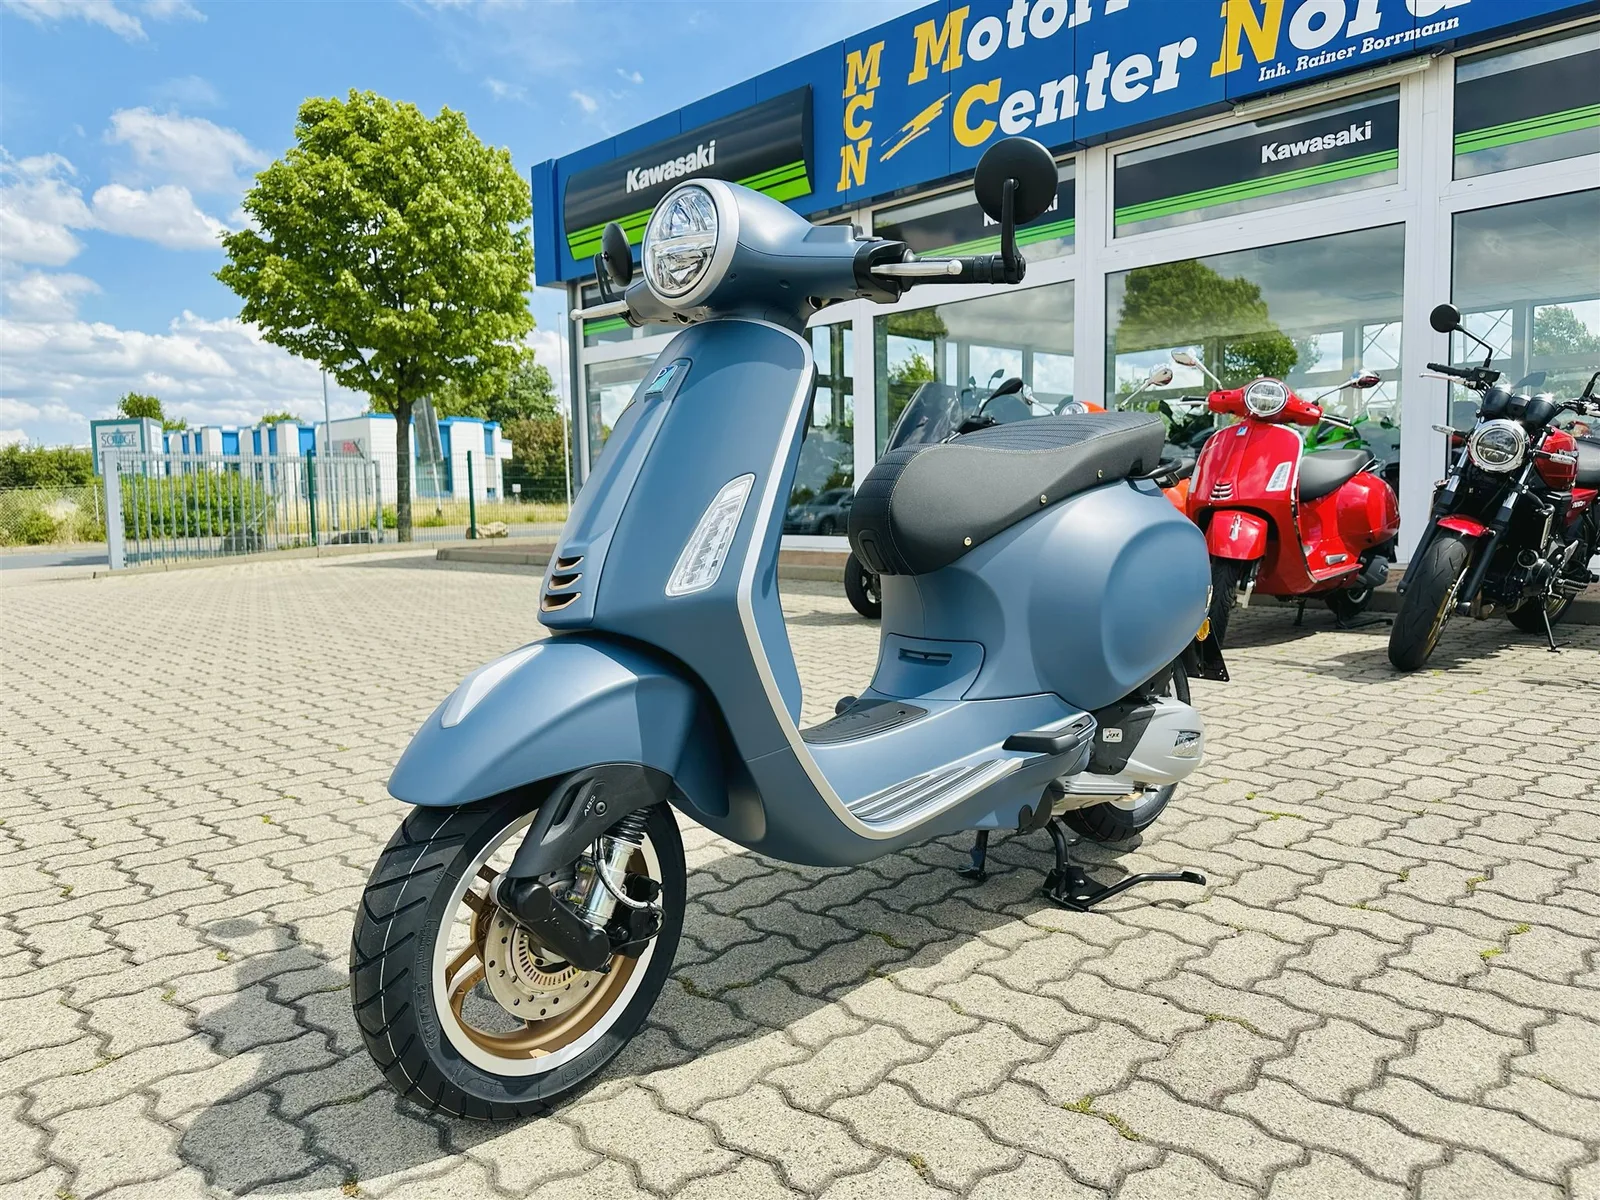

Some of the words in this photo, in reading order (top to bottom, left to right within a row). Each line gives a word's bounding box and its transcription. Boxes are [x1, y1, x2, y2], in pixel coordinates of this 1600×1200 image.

[952, 37, 1198, 147] Center
[1210, 0, 1472, 78] Nor
[1258, 61, 1291, 82] Inh.
[1295, 45, 1356, 73] Rainer
[1360, 16, 1460, 54] Borrmann
[836, 40, 885, 193] MCN
[1260, 120, 1372, 164] Kawasaki
[625, 139, 717, 195] Kawasaki
[584, 794, 596, 817] ABS
